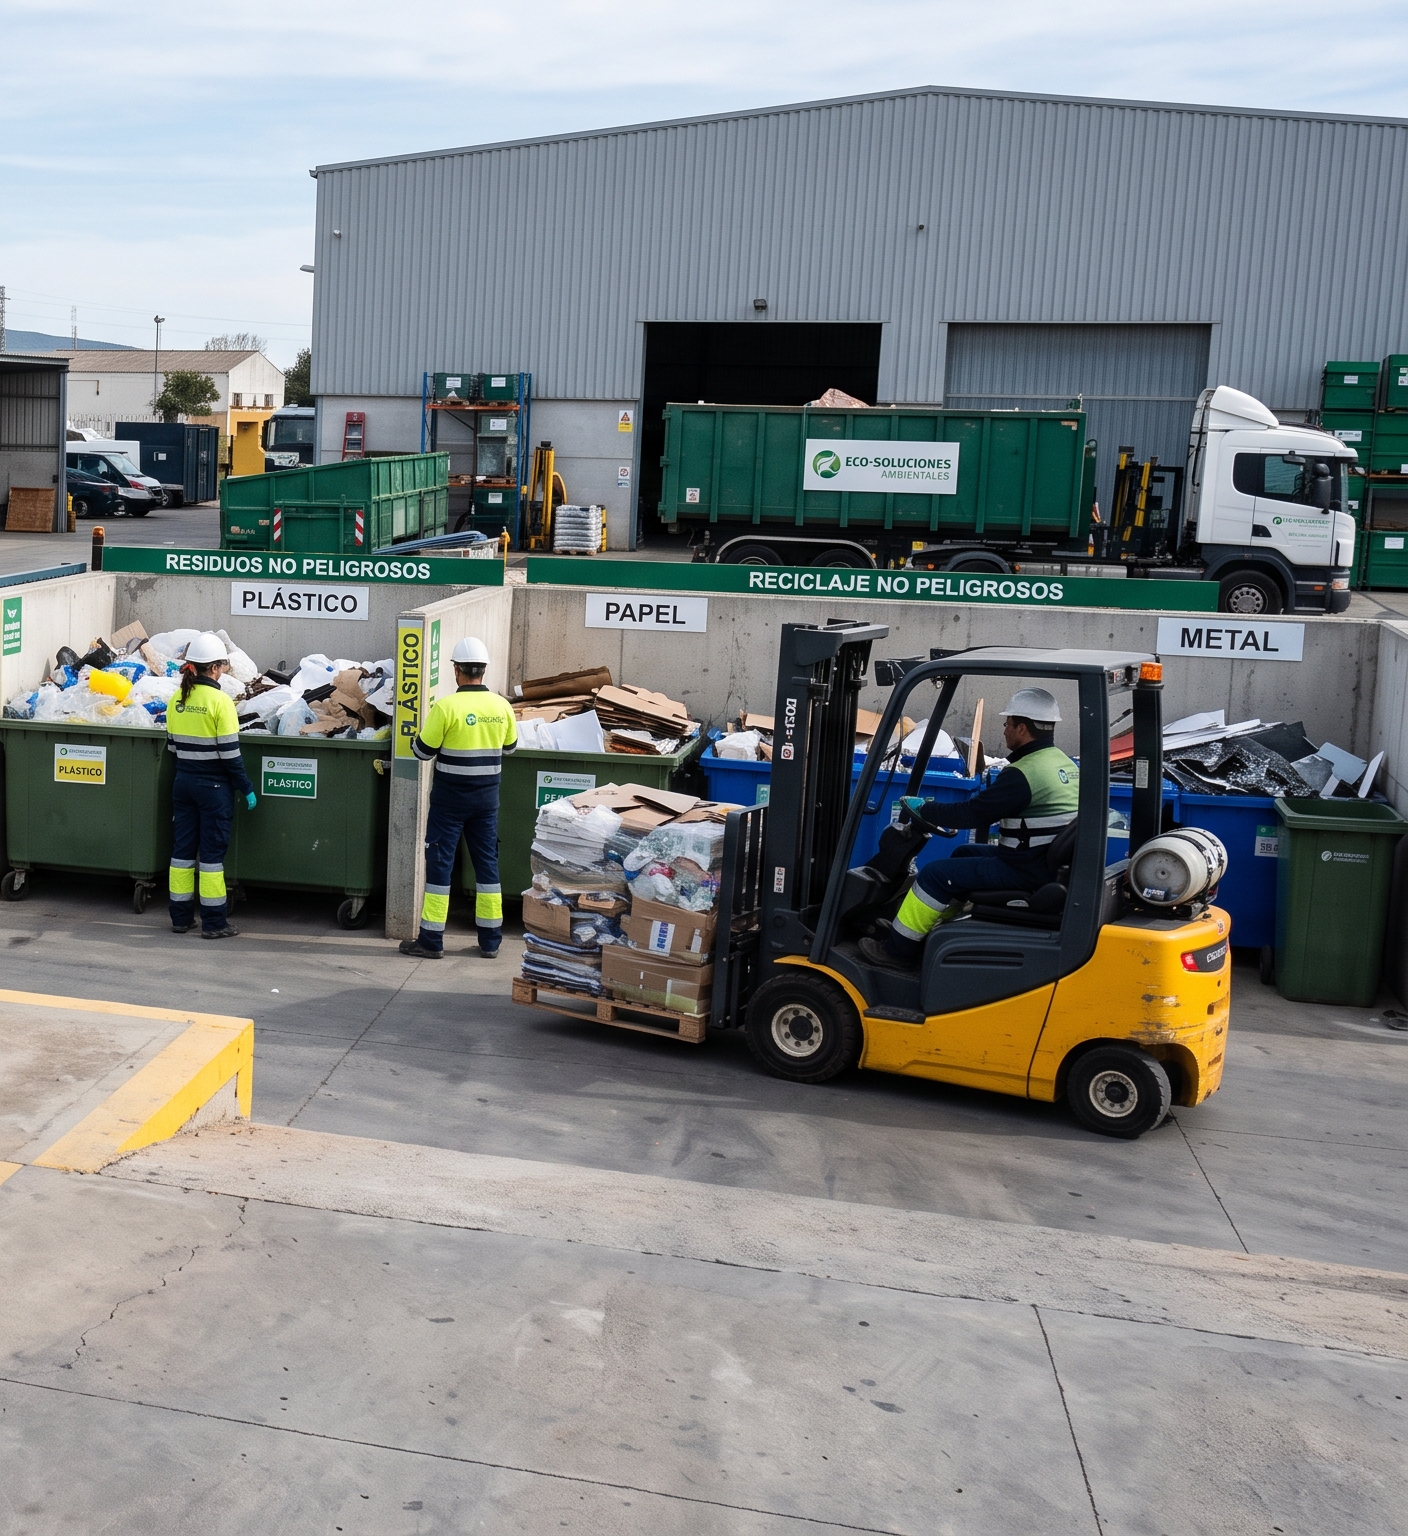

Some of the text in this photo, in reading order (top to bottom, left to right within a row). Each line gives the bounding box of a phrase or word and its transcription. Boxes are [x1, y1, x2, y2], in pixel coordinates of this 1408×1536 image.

[845, 456, 951, 470] ECO-SOLUCIONES
[881, 470, 950, 480] AMBIENTALES
[166, 554, 431, 580] RESIDUOS NO PELIGROSOS
[749, 571, 1064, 601] RECICLAJE NO PELIGROSOS
[242, 587, 358, 613] PLÁSTICO
[605, 602, 686, 625] PAPEL
[1180, 627, 1279, 652] METAL
[398, 633, 420, 737] PLÁSTICO
